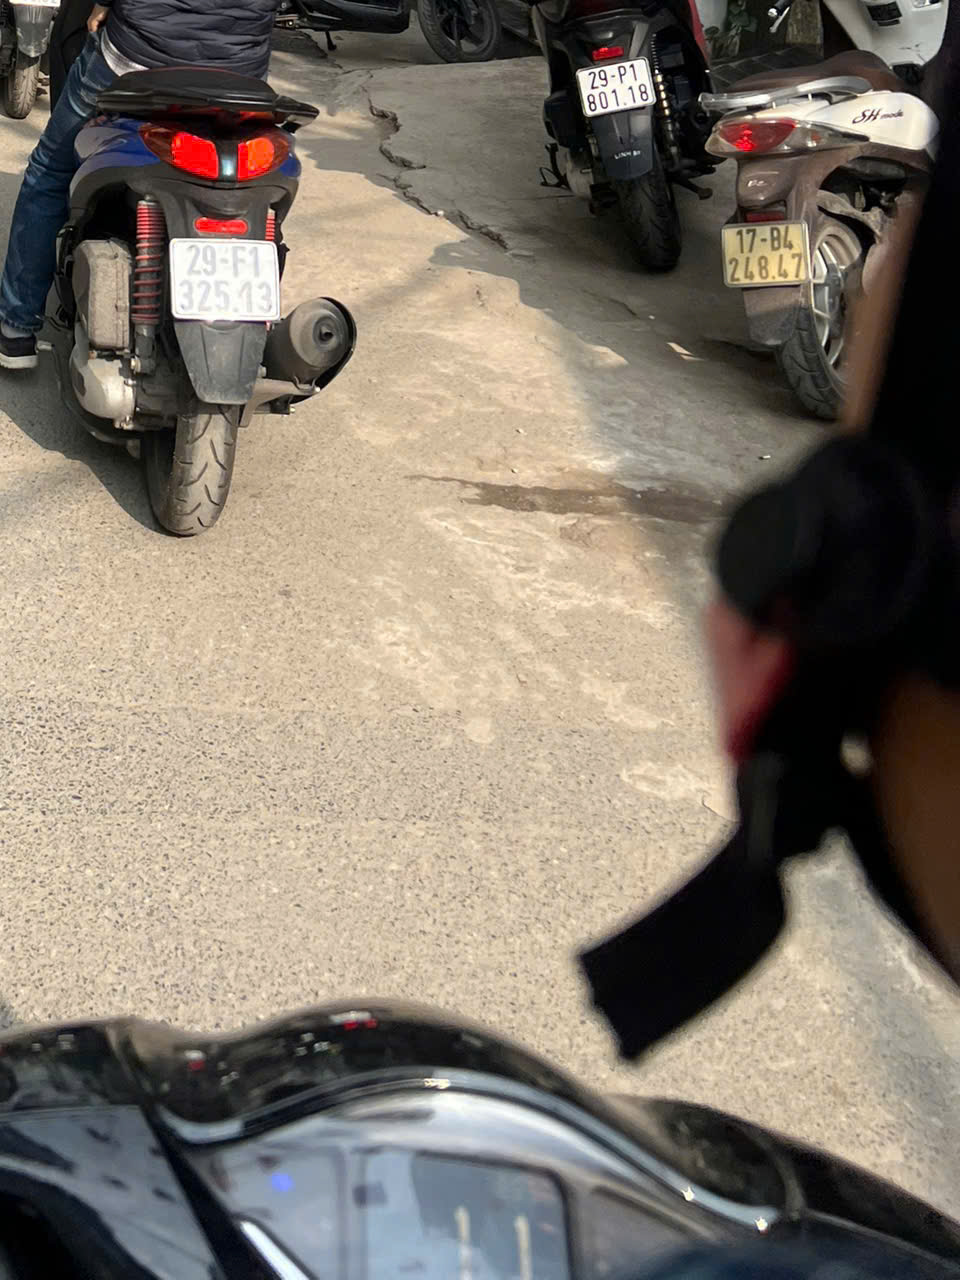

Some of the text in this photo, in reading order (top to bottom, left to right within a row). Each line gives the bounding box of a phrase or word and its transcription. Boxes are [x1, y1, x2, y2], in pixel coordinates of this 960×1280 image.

[588, 63, 638, 91] 29-P1
[586, 83, 650, 113] 801.18
[852, 108, 882, 124] SH
[736, 226, 794, 255] 17-B4
[186, 244, 261, 279] 29-F1
[728, 253, 804, 282] 248.47
[179, 280, 273, 314] 325.13
